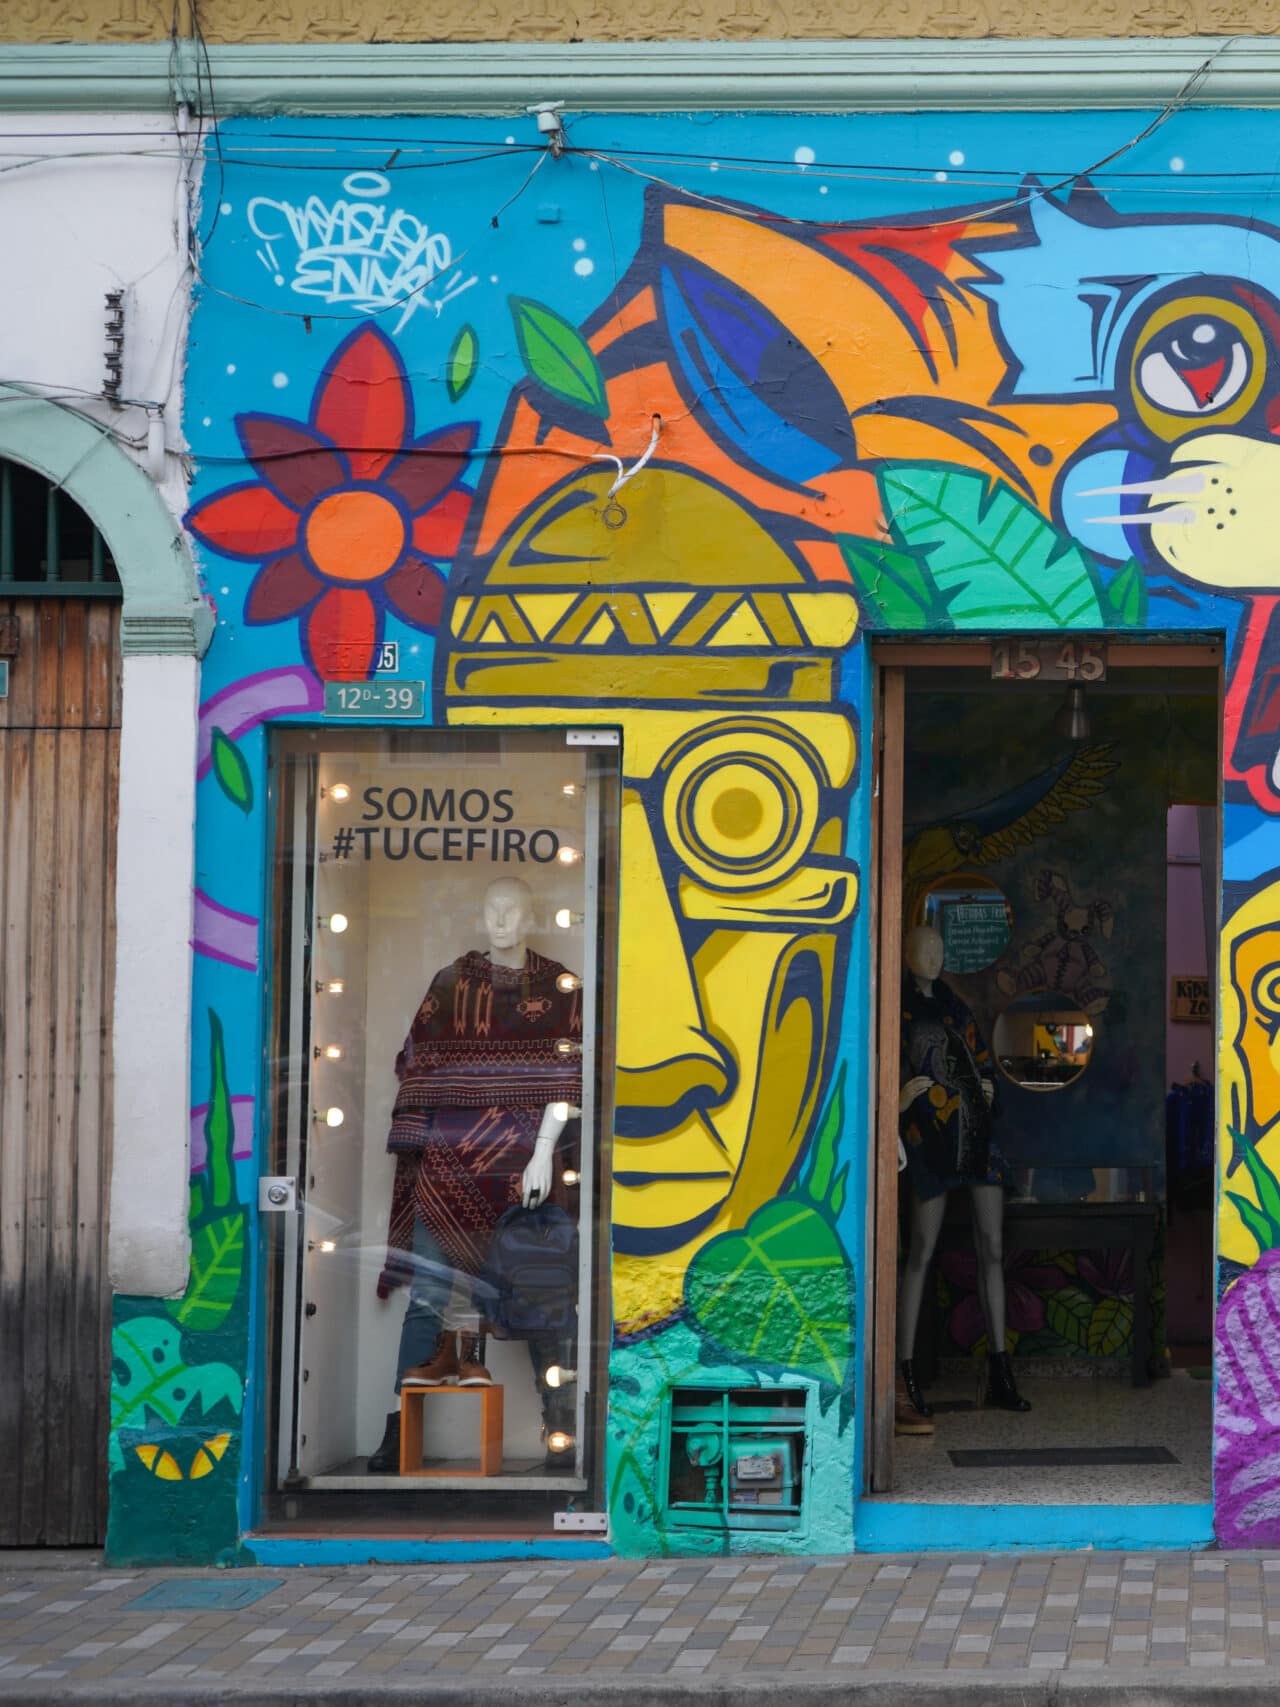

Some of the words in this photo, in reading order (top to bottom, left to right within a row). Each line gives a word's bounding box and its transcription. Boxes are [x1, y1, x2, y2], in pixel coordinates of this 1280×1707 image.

[992, 642, 1041, 680] 15
[1055, 642, 1105, 681] 45
[361, 786, 515, 824] SOMOS
[332, 826, 560, 864] #TUCEFIRO
